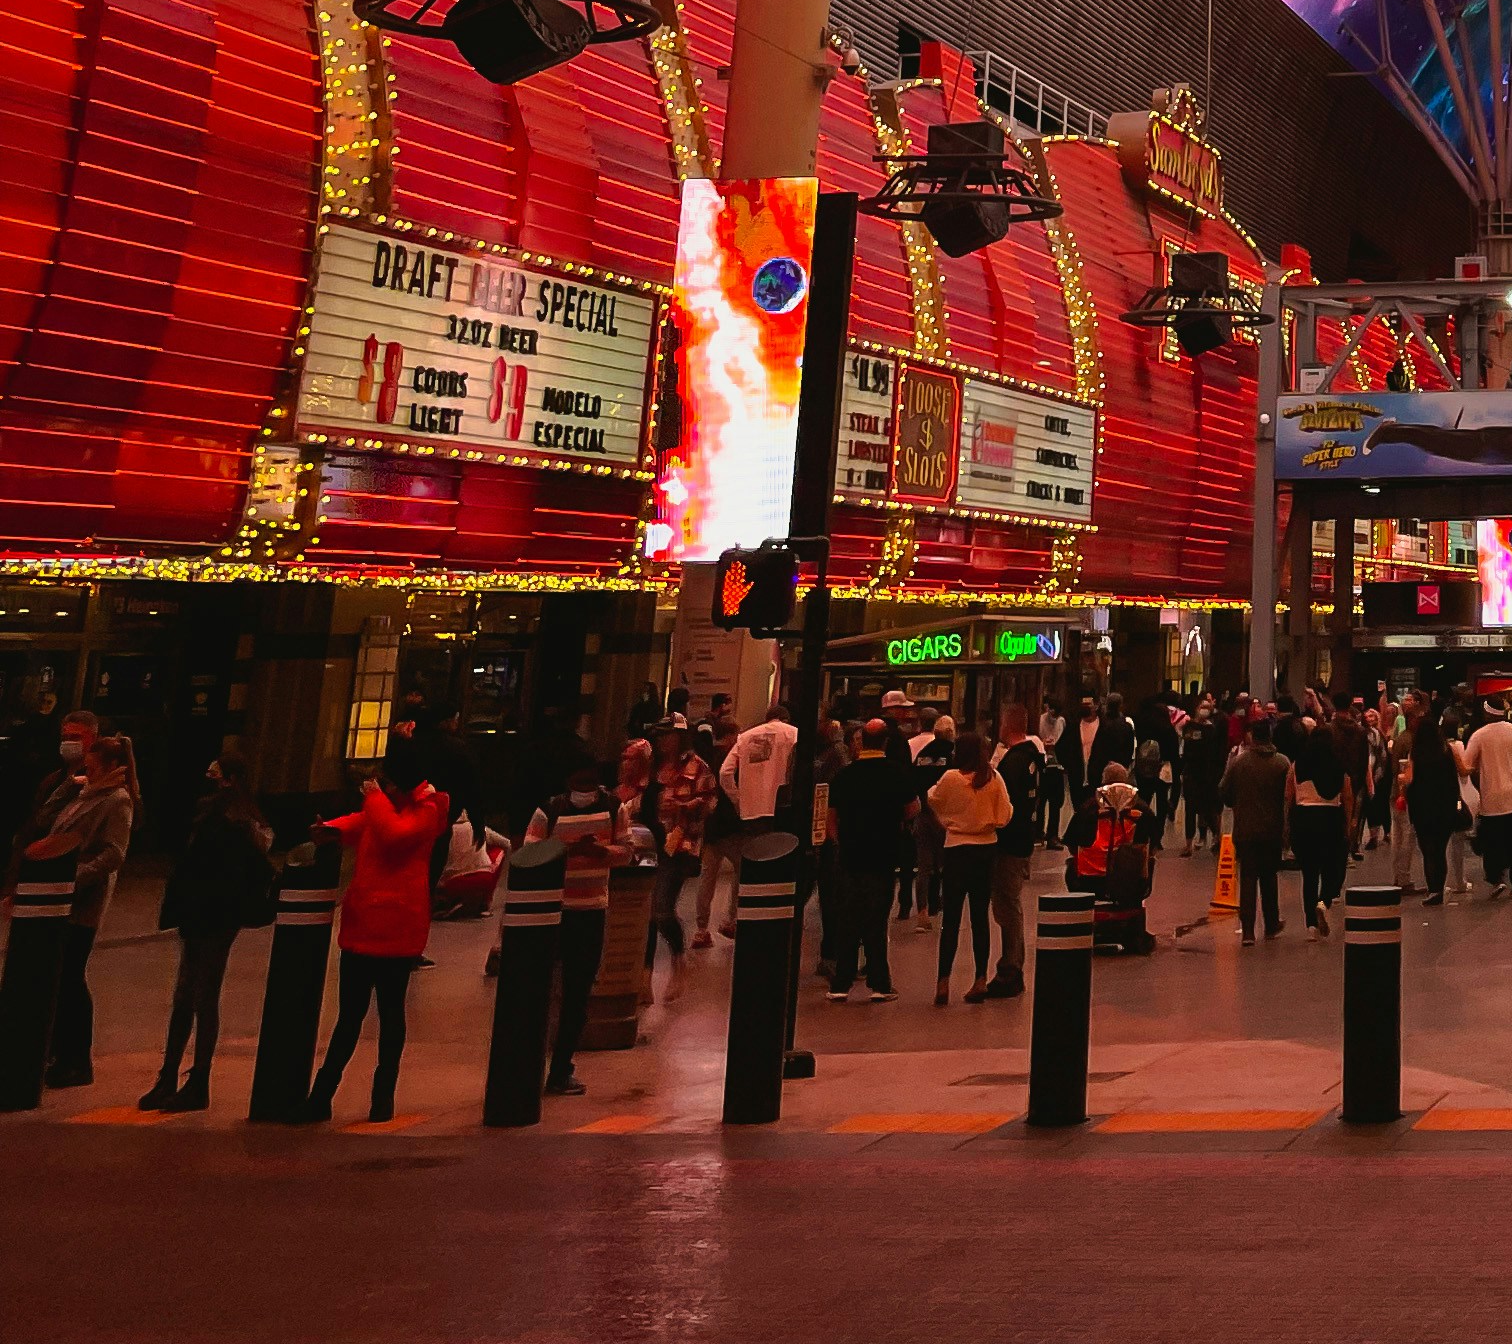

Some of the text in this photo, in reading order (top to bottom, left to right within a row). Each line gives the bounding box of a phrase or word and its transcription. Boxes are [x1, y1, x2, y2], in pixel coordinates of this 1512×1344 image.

[372, 241, 618, 337] DRAFT BEER SPECIAL
[499, 324, 539, 356] BEER
[412, 365, 469, 399] COORS
[542, 386, 602, 419] MODELO
[907, 379, 951, 426] LOOSE
[409, 403, 463, 436] LIGHT
[533, 421, 607, 454] ESPECIAL
[904, 446, 947, 488] SLOTS
[1302, 446, 1356, 466] SUPER HERO
[887, 633, 962, 664] CIGARS
